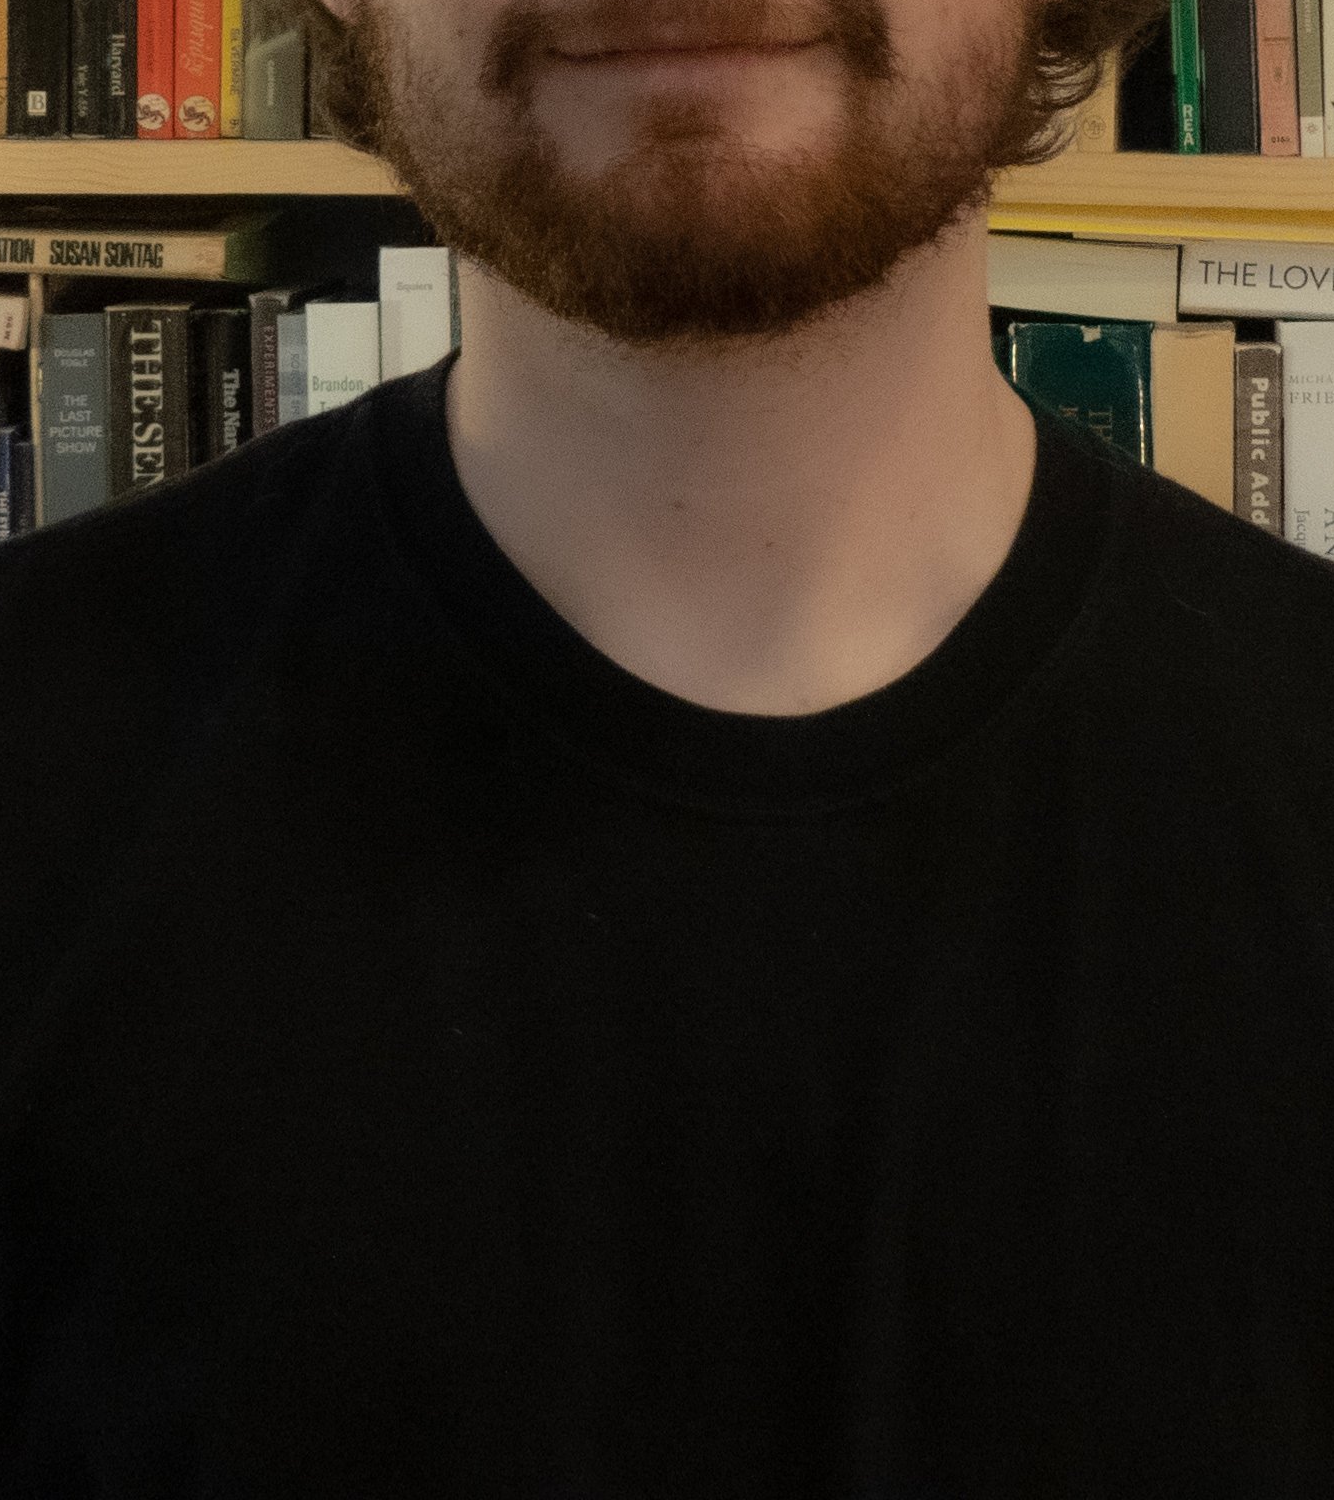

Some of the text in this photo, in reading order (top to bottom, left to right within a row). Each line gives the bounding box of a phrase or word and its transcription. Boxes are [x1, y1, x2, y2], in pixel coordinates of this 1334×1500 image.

[50, 239, 100, 266] SUSAN
[104, 241, 163, 268] SONTAG
[1198, 260, 1257, 287] THE
